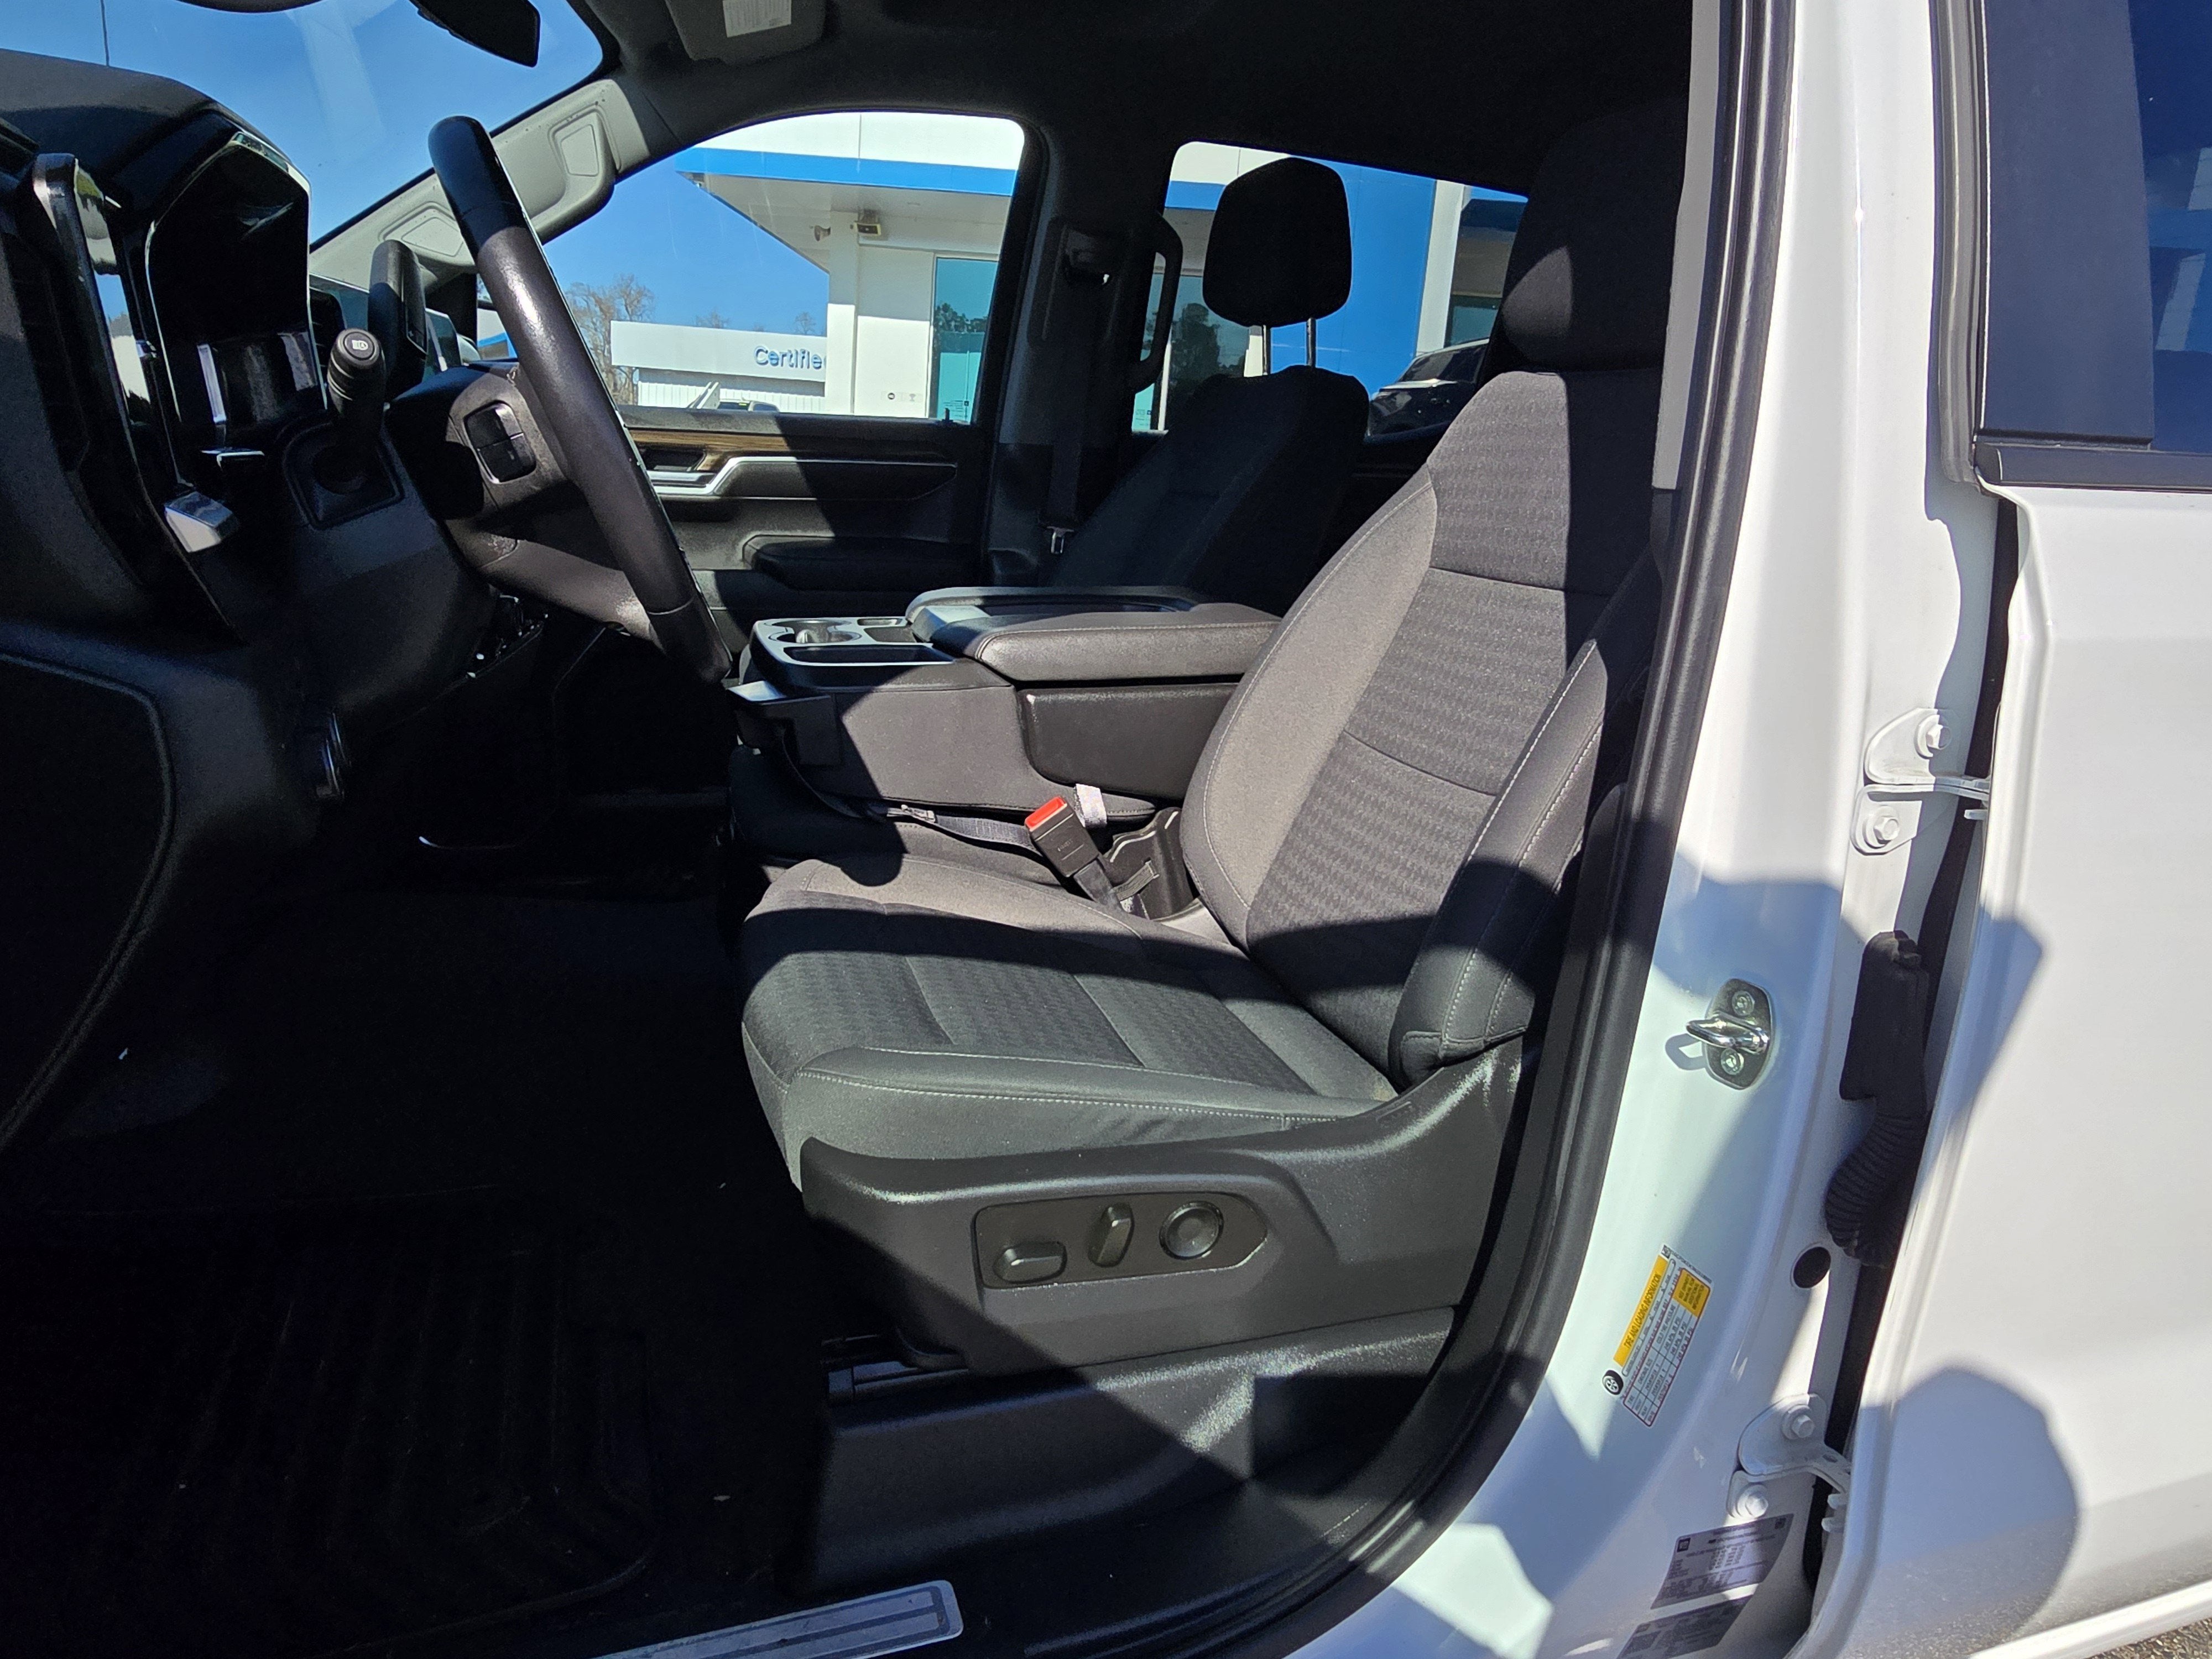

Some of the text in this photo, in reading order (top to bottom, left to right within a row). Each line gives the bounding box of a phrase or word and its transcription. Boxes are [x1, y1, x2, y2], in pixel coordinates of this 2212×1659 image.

[754, 346, 826, 370] Certifie
[1642, 1271, 1661, 1306] INFORMATION
[1632, 1302, 1648, 1328] LOADING
[1623, 1334, 1634, 1349] TIRE
[1628, 1324, 1639, 1338] AND
